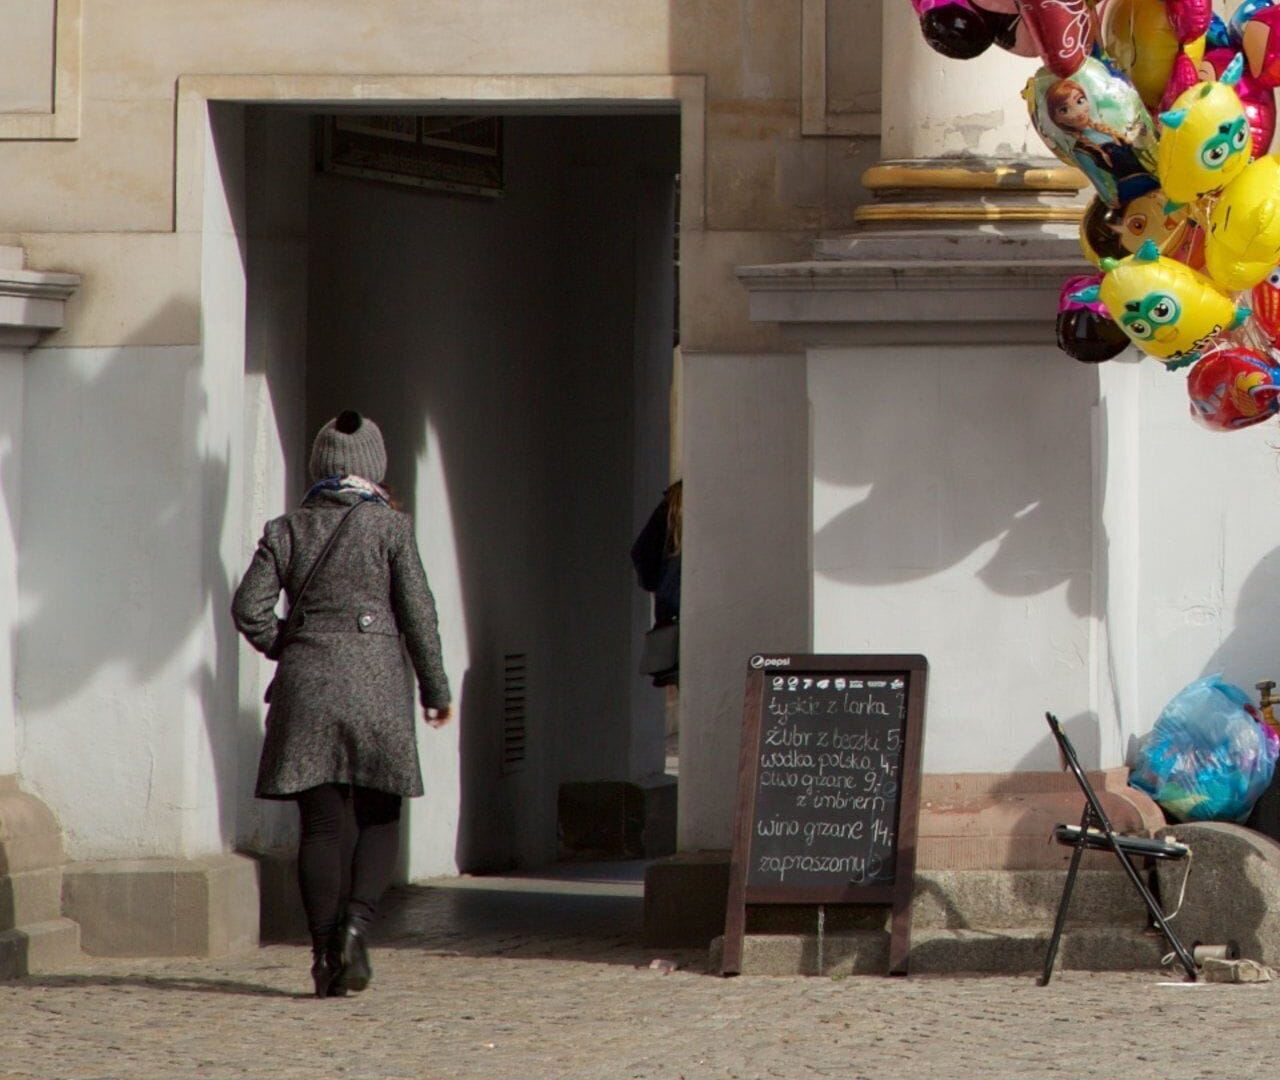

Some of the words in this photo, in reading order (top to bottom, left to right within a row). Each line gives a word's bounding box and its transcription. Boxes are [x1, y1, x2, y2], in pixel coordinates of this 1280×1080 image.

[764, 657, 790, 667] pepsi
[818, 751, 875, 776] polska
[801, 774, 856, 795] grzane
[757, 813, 799, 836] wino
[803, 821, 864, 846] grzane
[758, 855, 865, 884] zapraszamy
